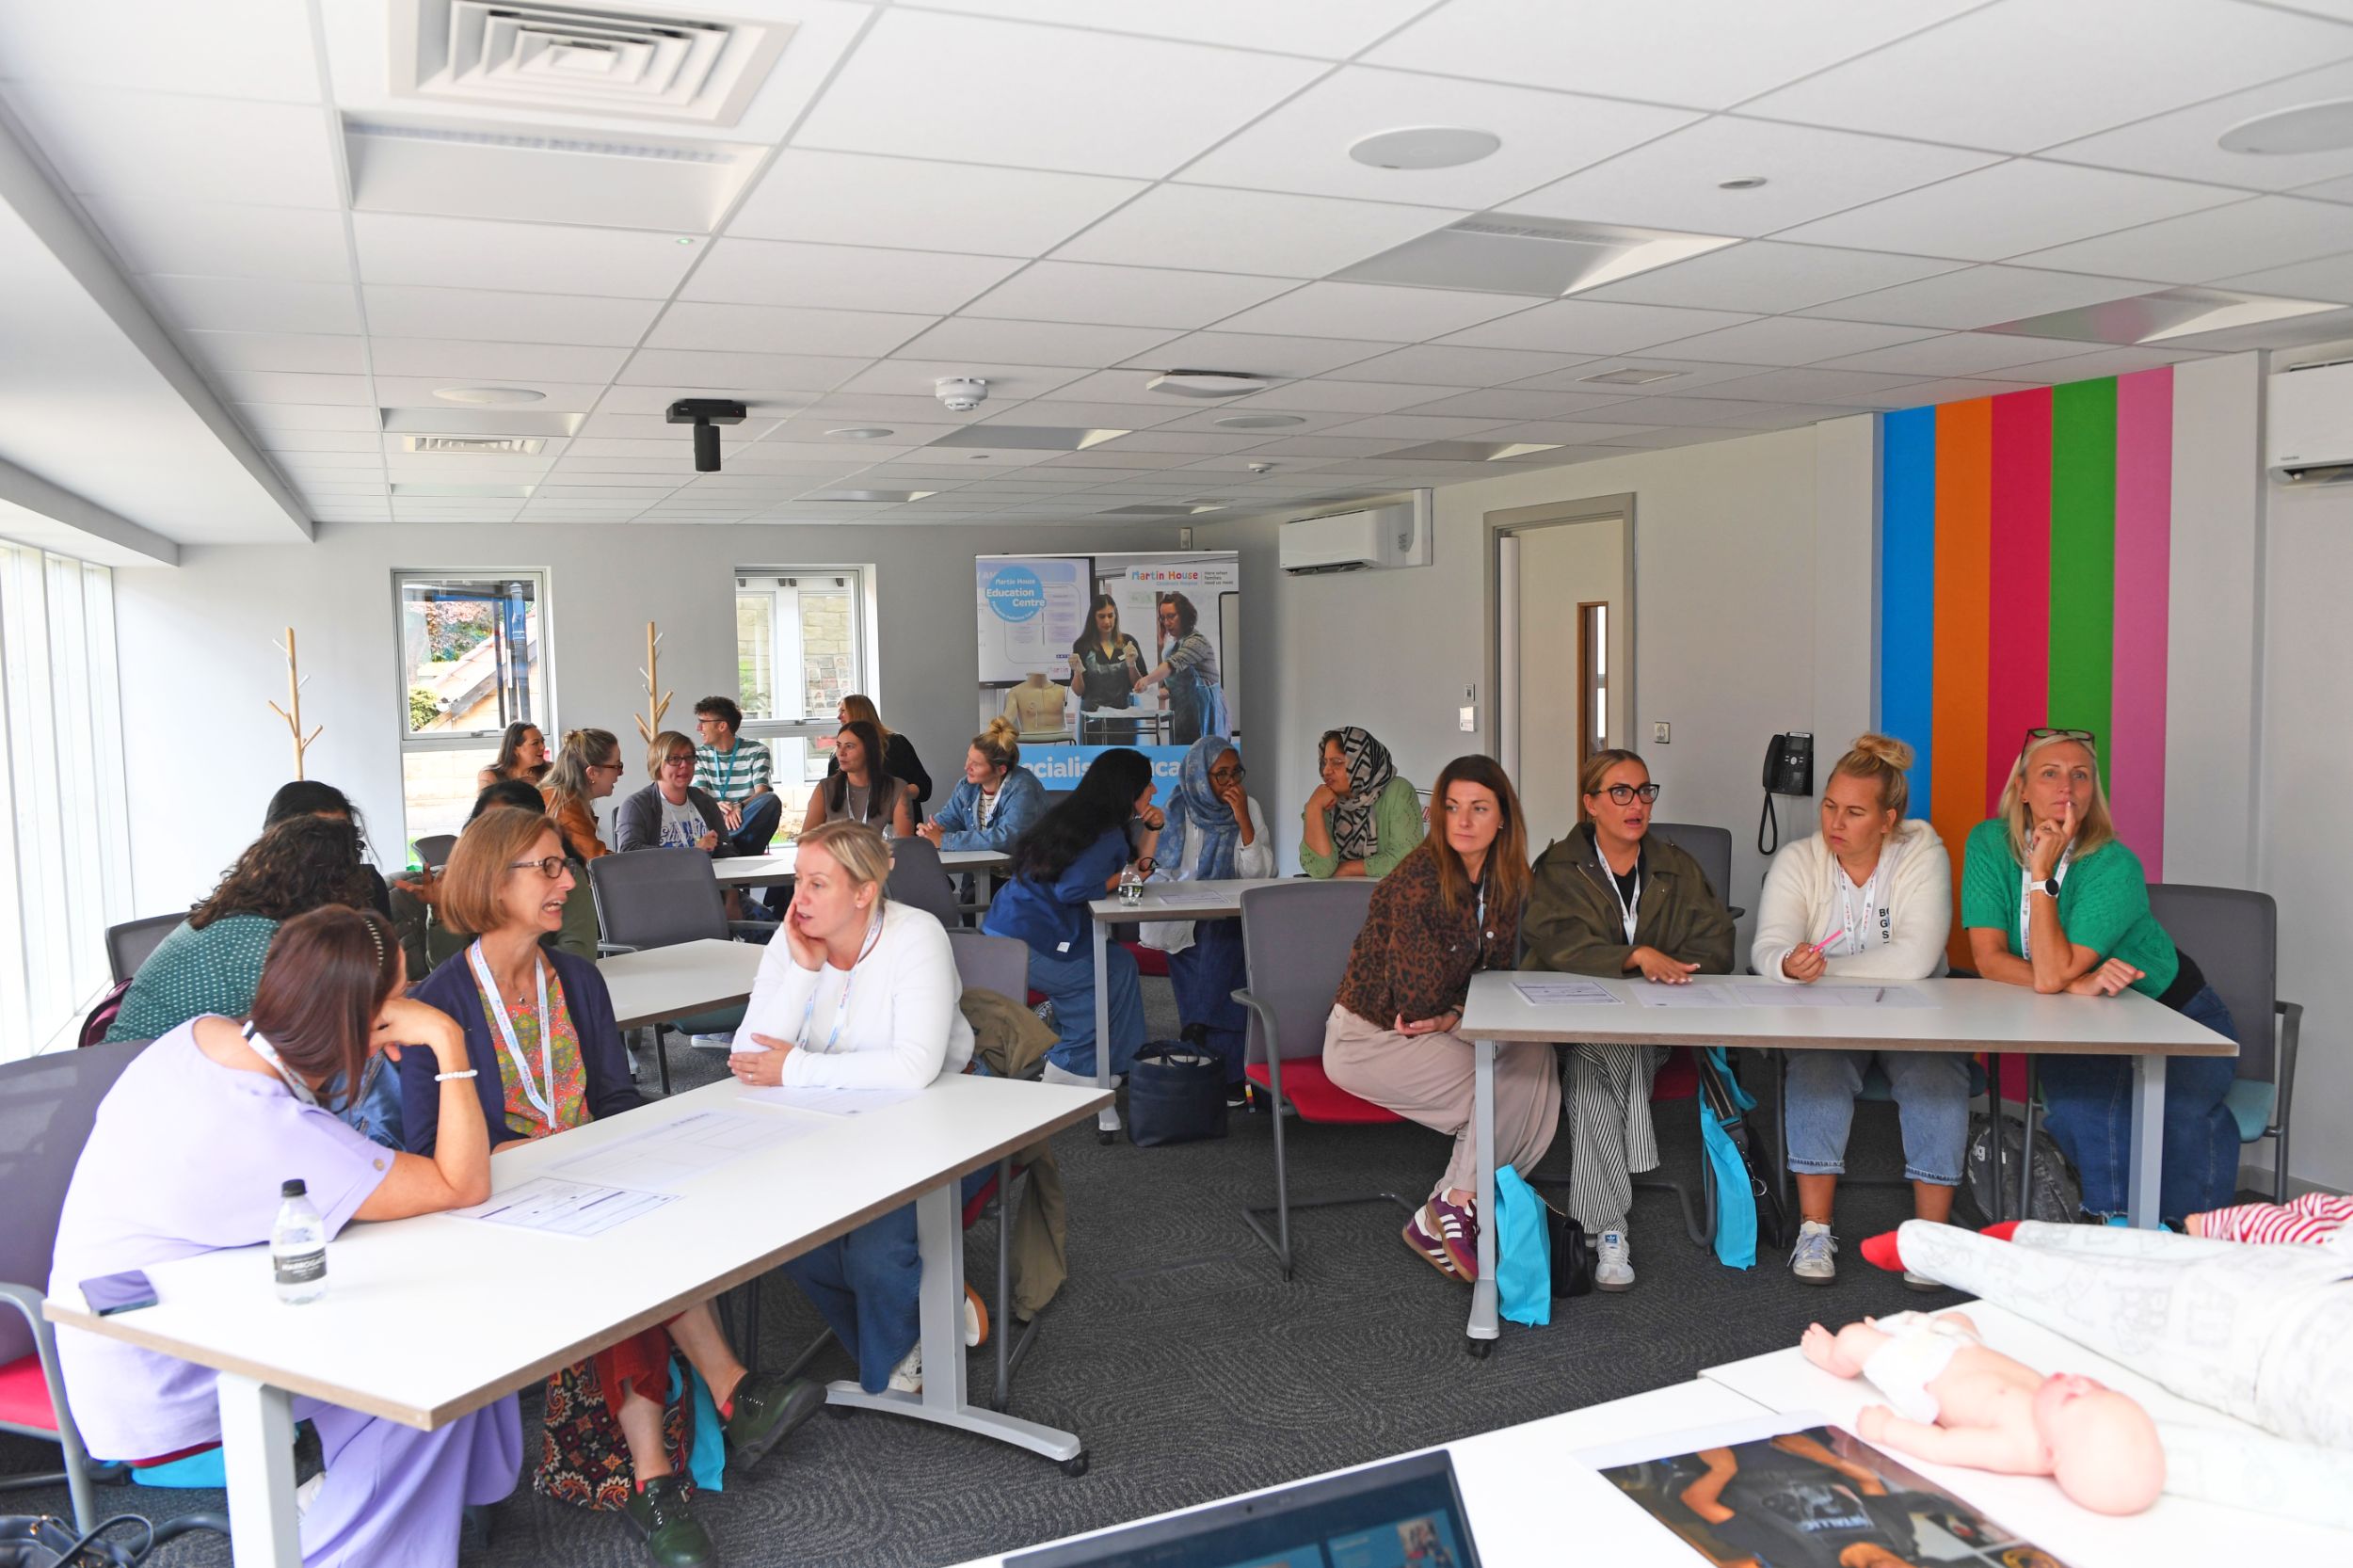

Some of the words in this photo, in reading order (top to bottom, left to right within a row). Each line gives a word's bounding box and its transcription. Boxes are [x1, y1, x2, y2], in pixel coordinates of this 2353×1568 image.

[1132, 571, 1164, 581] Martin
[1168, 571, 1198, 580] House
[986, 588, 1034, 597] Education
[1013, 599, 1046, 607] Centre
